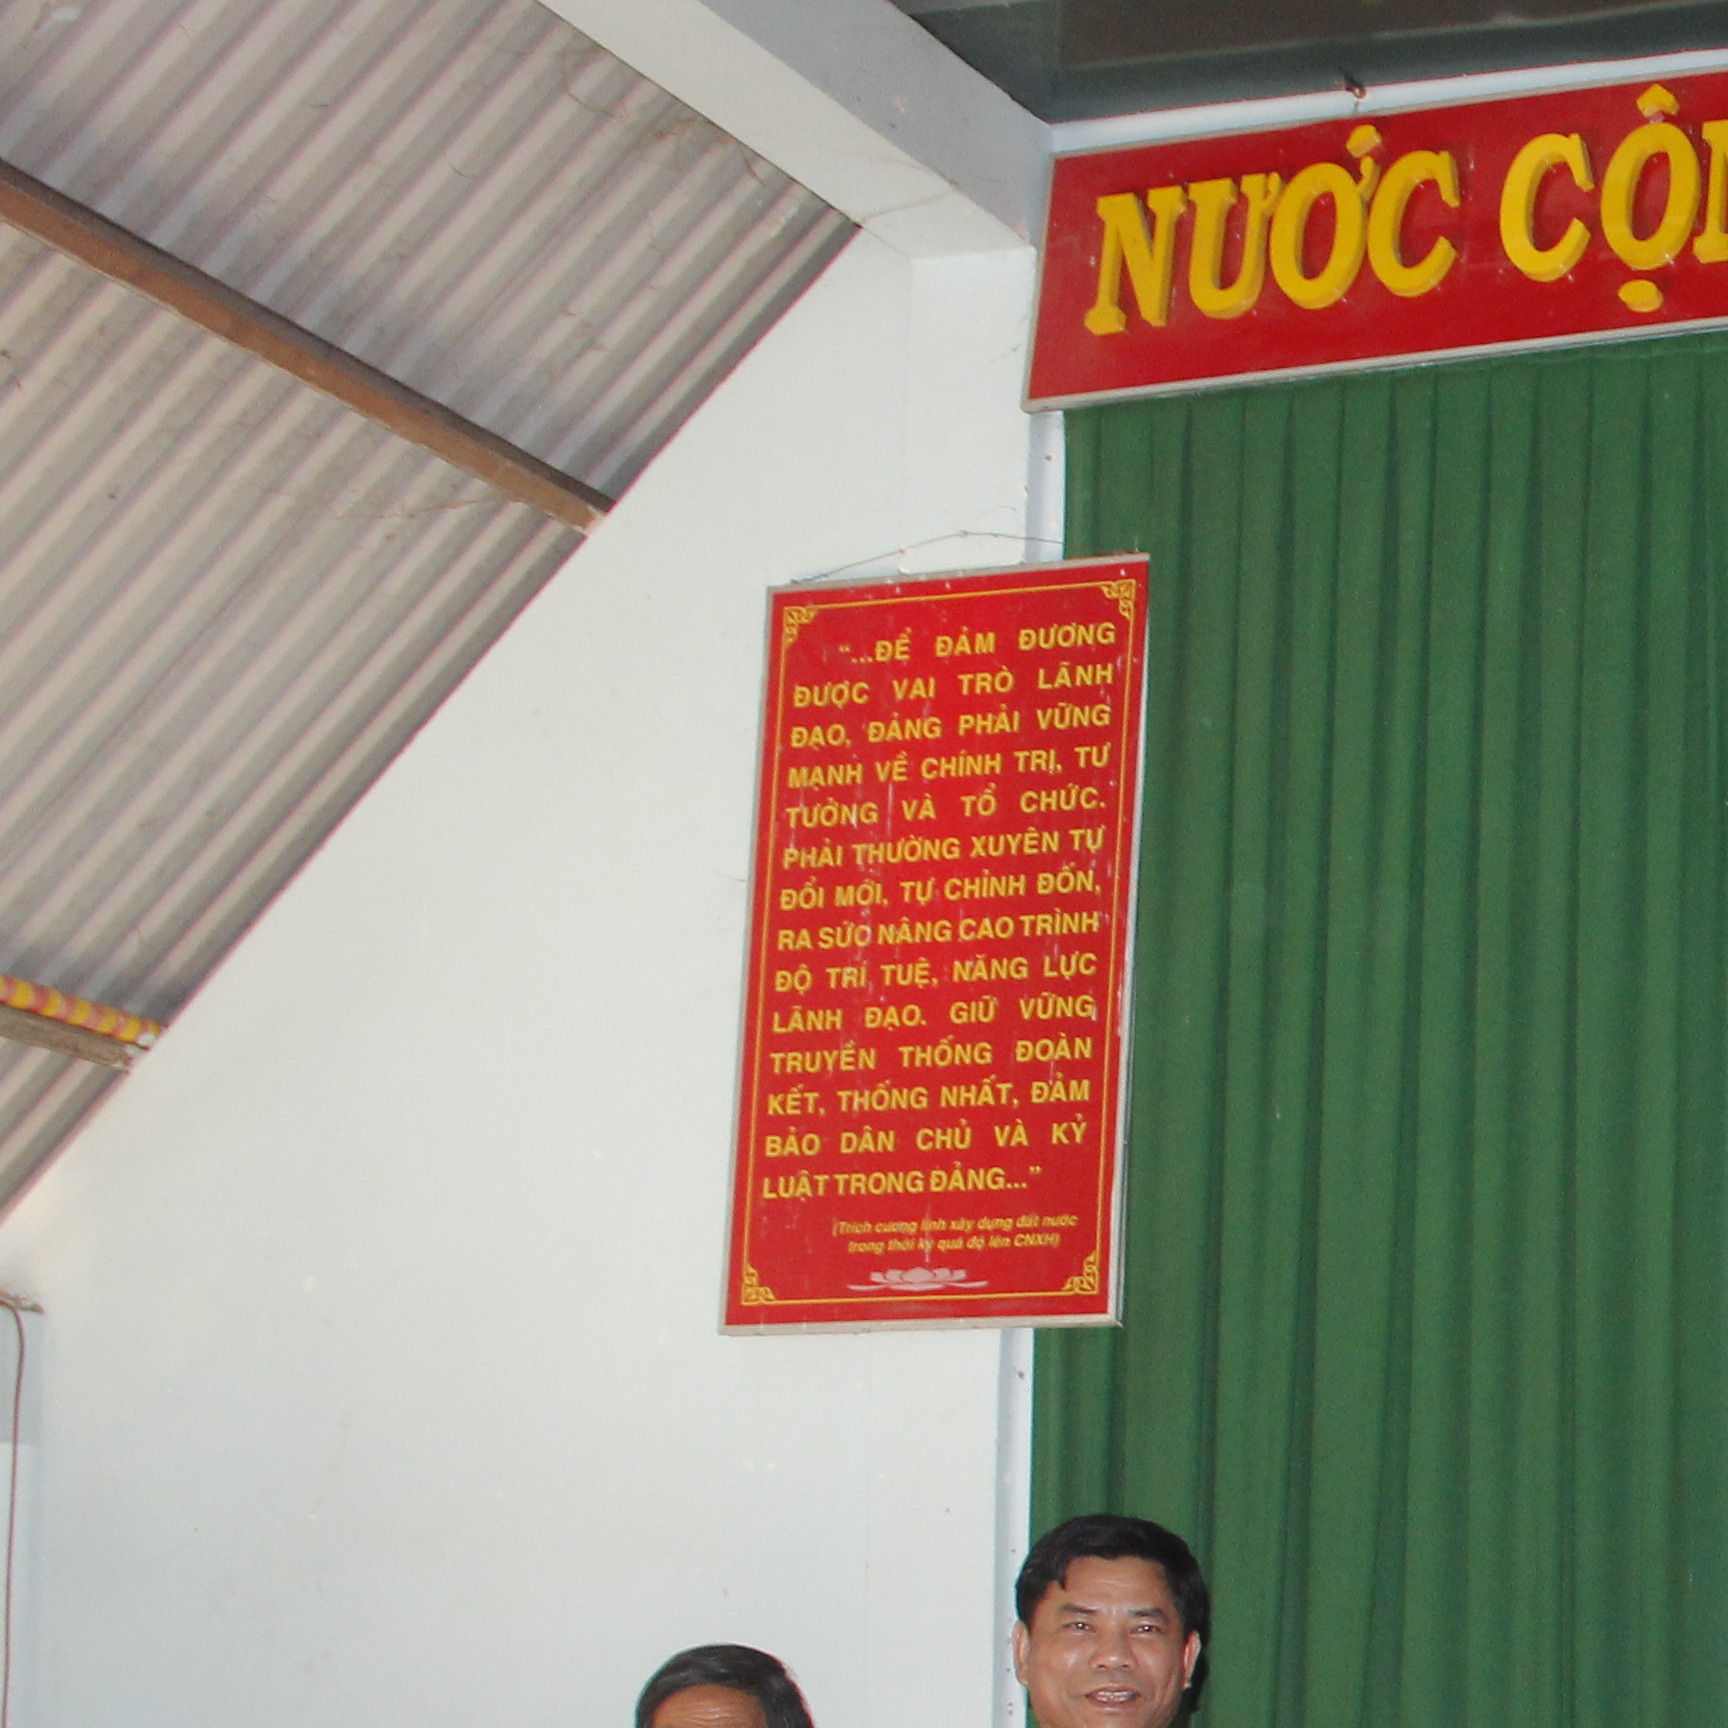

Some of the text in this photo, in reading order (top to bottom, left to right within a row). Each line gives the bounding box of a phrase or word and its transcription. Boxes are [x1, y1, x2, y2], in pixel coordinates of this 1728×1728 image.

[1084, 124, 1460, 335] NƯỚC
[934, 626, 996, 657] ĐẢM
[1018, 622, 1116, 650] ĐƯƠNG
[793, 661, 1114, 708] ĐƯỢC VAI TRÒ LÃNH
[867, 712, 942, 743] ĐẢNG
[958, 704, 1020, 735] PHẢI
[1037, 702, 1111, 730] VỮNG
[787, 763, 863, 790] MẠNH
[875, 752, 908, 782] VỀ
[920, 750, 1002, 780] CHÍNH
[1075, 742, 1111, 768] TƯ
[901, 793, 937, 822] VÀ
[961, 784, 997, 816] TỔ
[783, 825, 1105, 869] PHẢI THƯỜNG XUYÊN TỰ
[780, 876, 825, 911] ĐỔI
[900, 878, 935, 905] TỰ
[944, 870, 1026, 901] CHỈNH
[777, 929, 813, 950] RA
[877, 917, 952, 944] NÂNG
[958, 916, 1015, 941] CAO
[1019, 908, 1100, 936] TRÌNH
[775, 964, 813, 995] ĐỘ
[826, 961, 867, 988] TRÍ
[952, 955, 1029, 982] NĂNG
[1044, 952, 1097, 980] LỰC
[772, 1005, 843, 1033] LÃNH
[1019, 992, 1096, 1020] VỮNG
[770, 1033, 1092, 1074] TRUYỀN THỐNG ĐOÀN
[837, 1080, 928, 1112] THỐNG
[1031, 1072, 1090, 1103] ĐẢM
[765, 1114, 1087, 1157] BẢO DÂN CHỦ VÀ KỶ
[763, 1169, 829, 1202] LUẬT
[833, 1170, 925, 1196] TRONG
